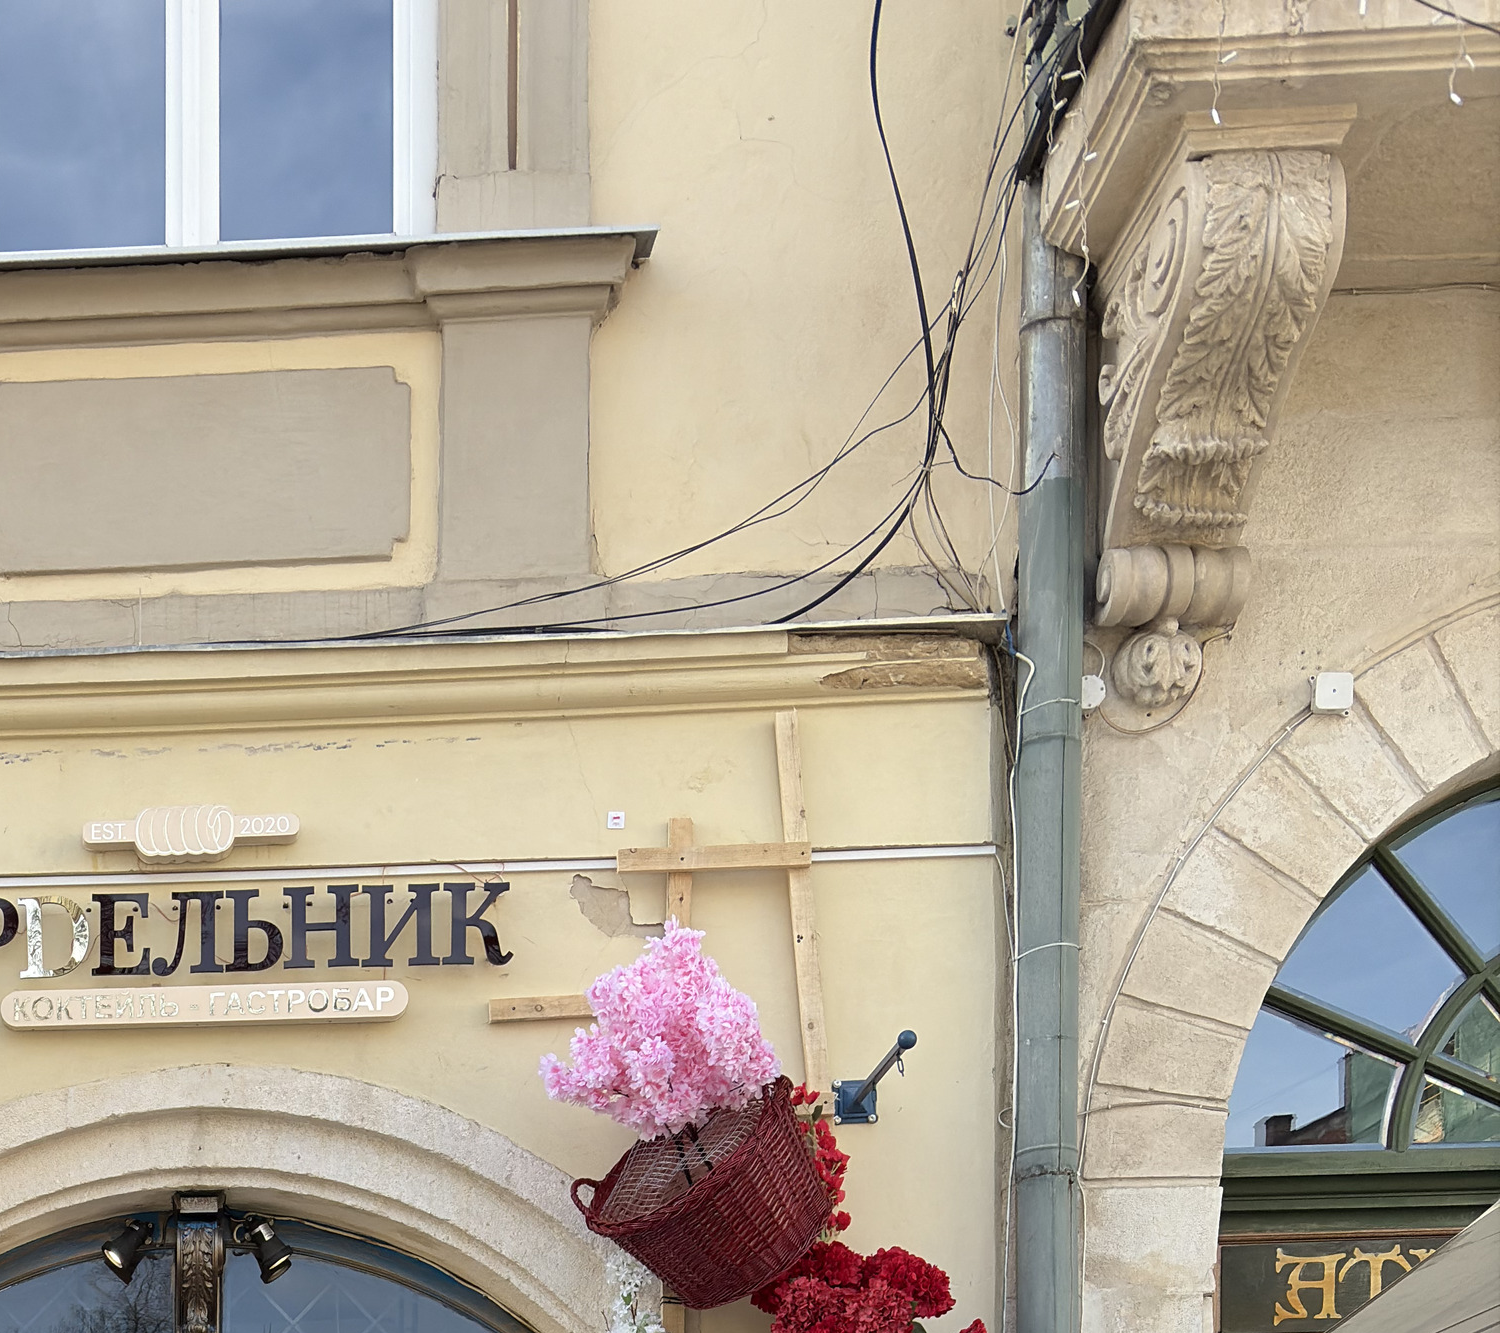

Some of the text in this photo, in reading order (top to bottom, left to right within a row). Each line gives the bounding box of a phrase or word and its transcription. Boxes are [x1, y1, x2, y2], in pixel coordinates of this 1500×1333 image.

[91, 816, 290, 841] EST. 2020
[12, 990, 180, 1022] КОКТЕЙЛЬ
[208, 986, 396, 1017] ГАСТРОБАР
